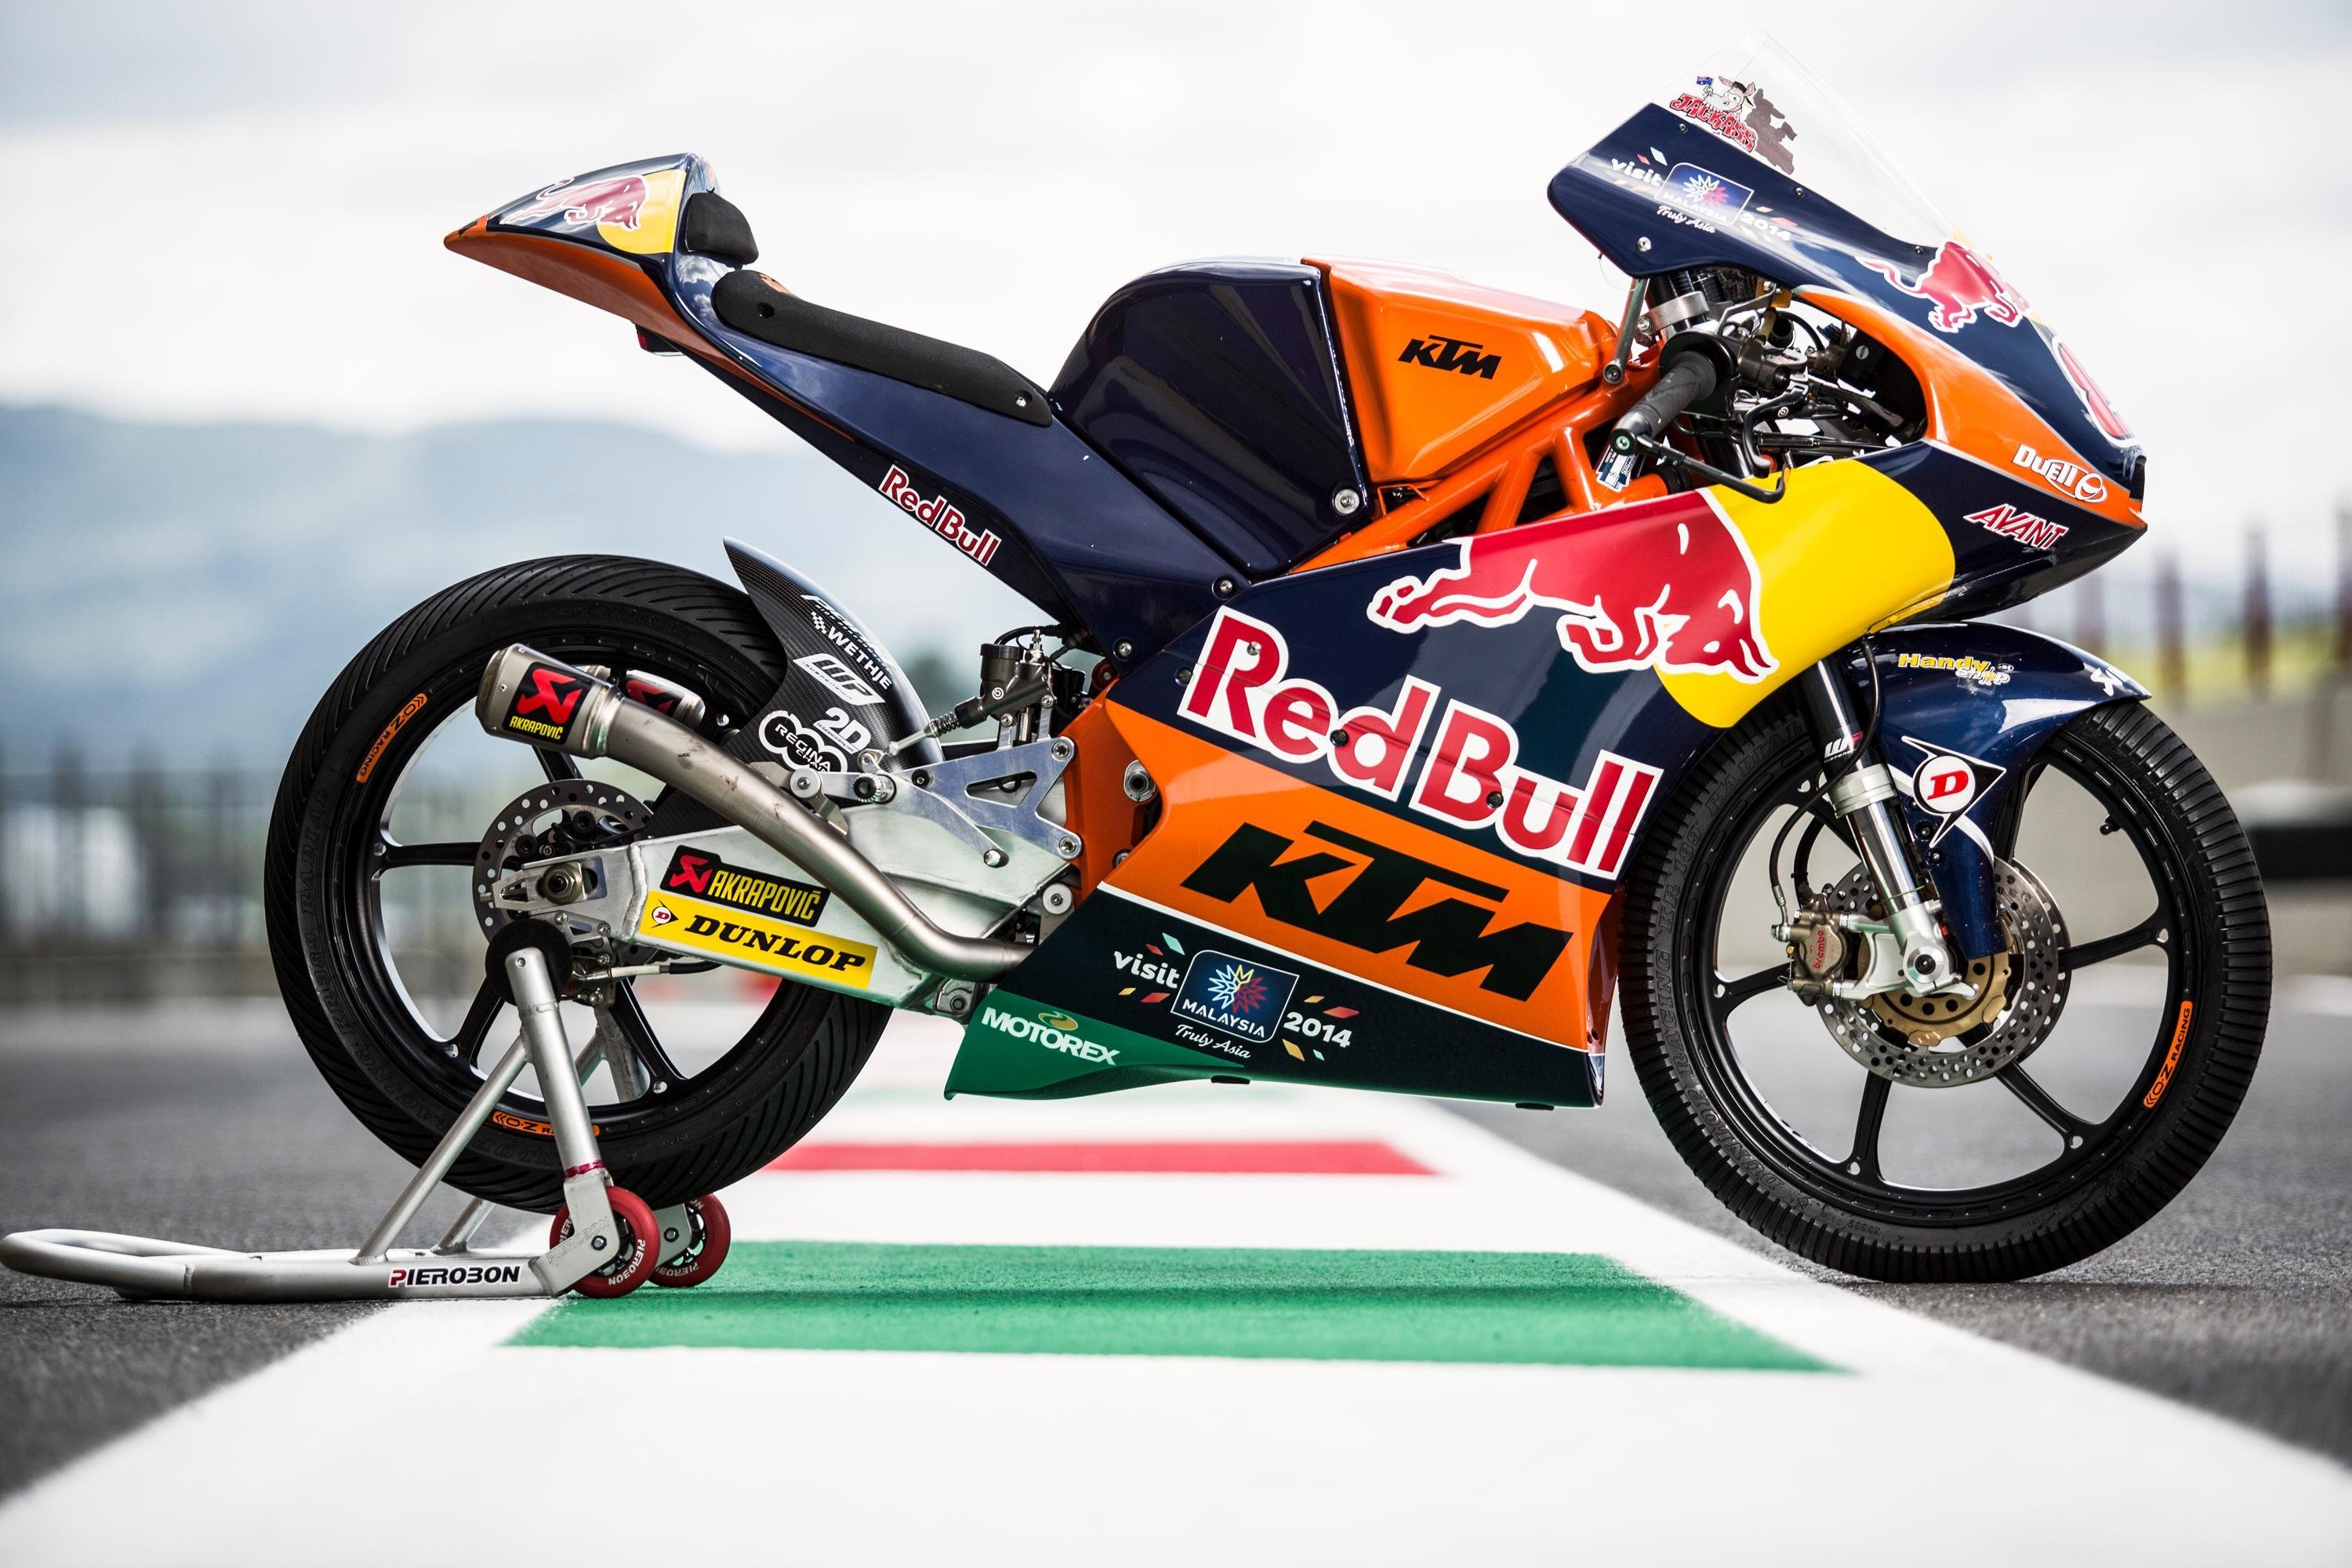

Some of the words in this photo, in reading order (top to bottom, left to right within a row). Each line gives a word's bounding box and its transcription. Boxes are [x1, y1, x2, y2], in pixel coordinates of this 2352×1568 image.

[1670, 93, 1756, 152] JACKASS
[1612, 158, 1664, 187] visit
[1657, 205, 1687, 223] Truly
[1686, 219, 1716, 234] Asia
[1740, 212, 1791, 241] 2014
[1398, 335, 1501, 379] KTM
[1963, 503, 2069, 549] AVANT
[828, 626, 892, 689] WETHJE
[1898, 653, 1991, 672] Handy
[775, 724, 831, 772] REGINA
[812, 706, 871, 754] 2D
[359, 730, 391, 776] RACING
[1927, 770, 1969, 800] D
[1180, 820, 1573, 1002] KTM
[684, 915, 866, 971] DUNLOP
[1813, 930, 1824, 969] brembo
[1114, 951, 1180, 989] visit
[982, 1007, 1120, 1065] MOTOREX
[1182, 998, 1265, 1038] MALAYSIA
[1283, 1012, 1353, 1048] 2014
[2171, 1008, 2190, 1061] RACING
[1175, 1024, 1214, 1047] Truly
[1212, 1039, 1251, 1058] Asia
[390, 1266, 521, 1286] PIEROBON
[608, 1240, 646, 1285] PIEROBON
